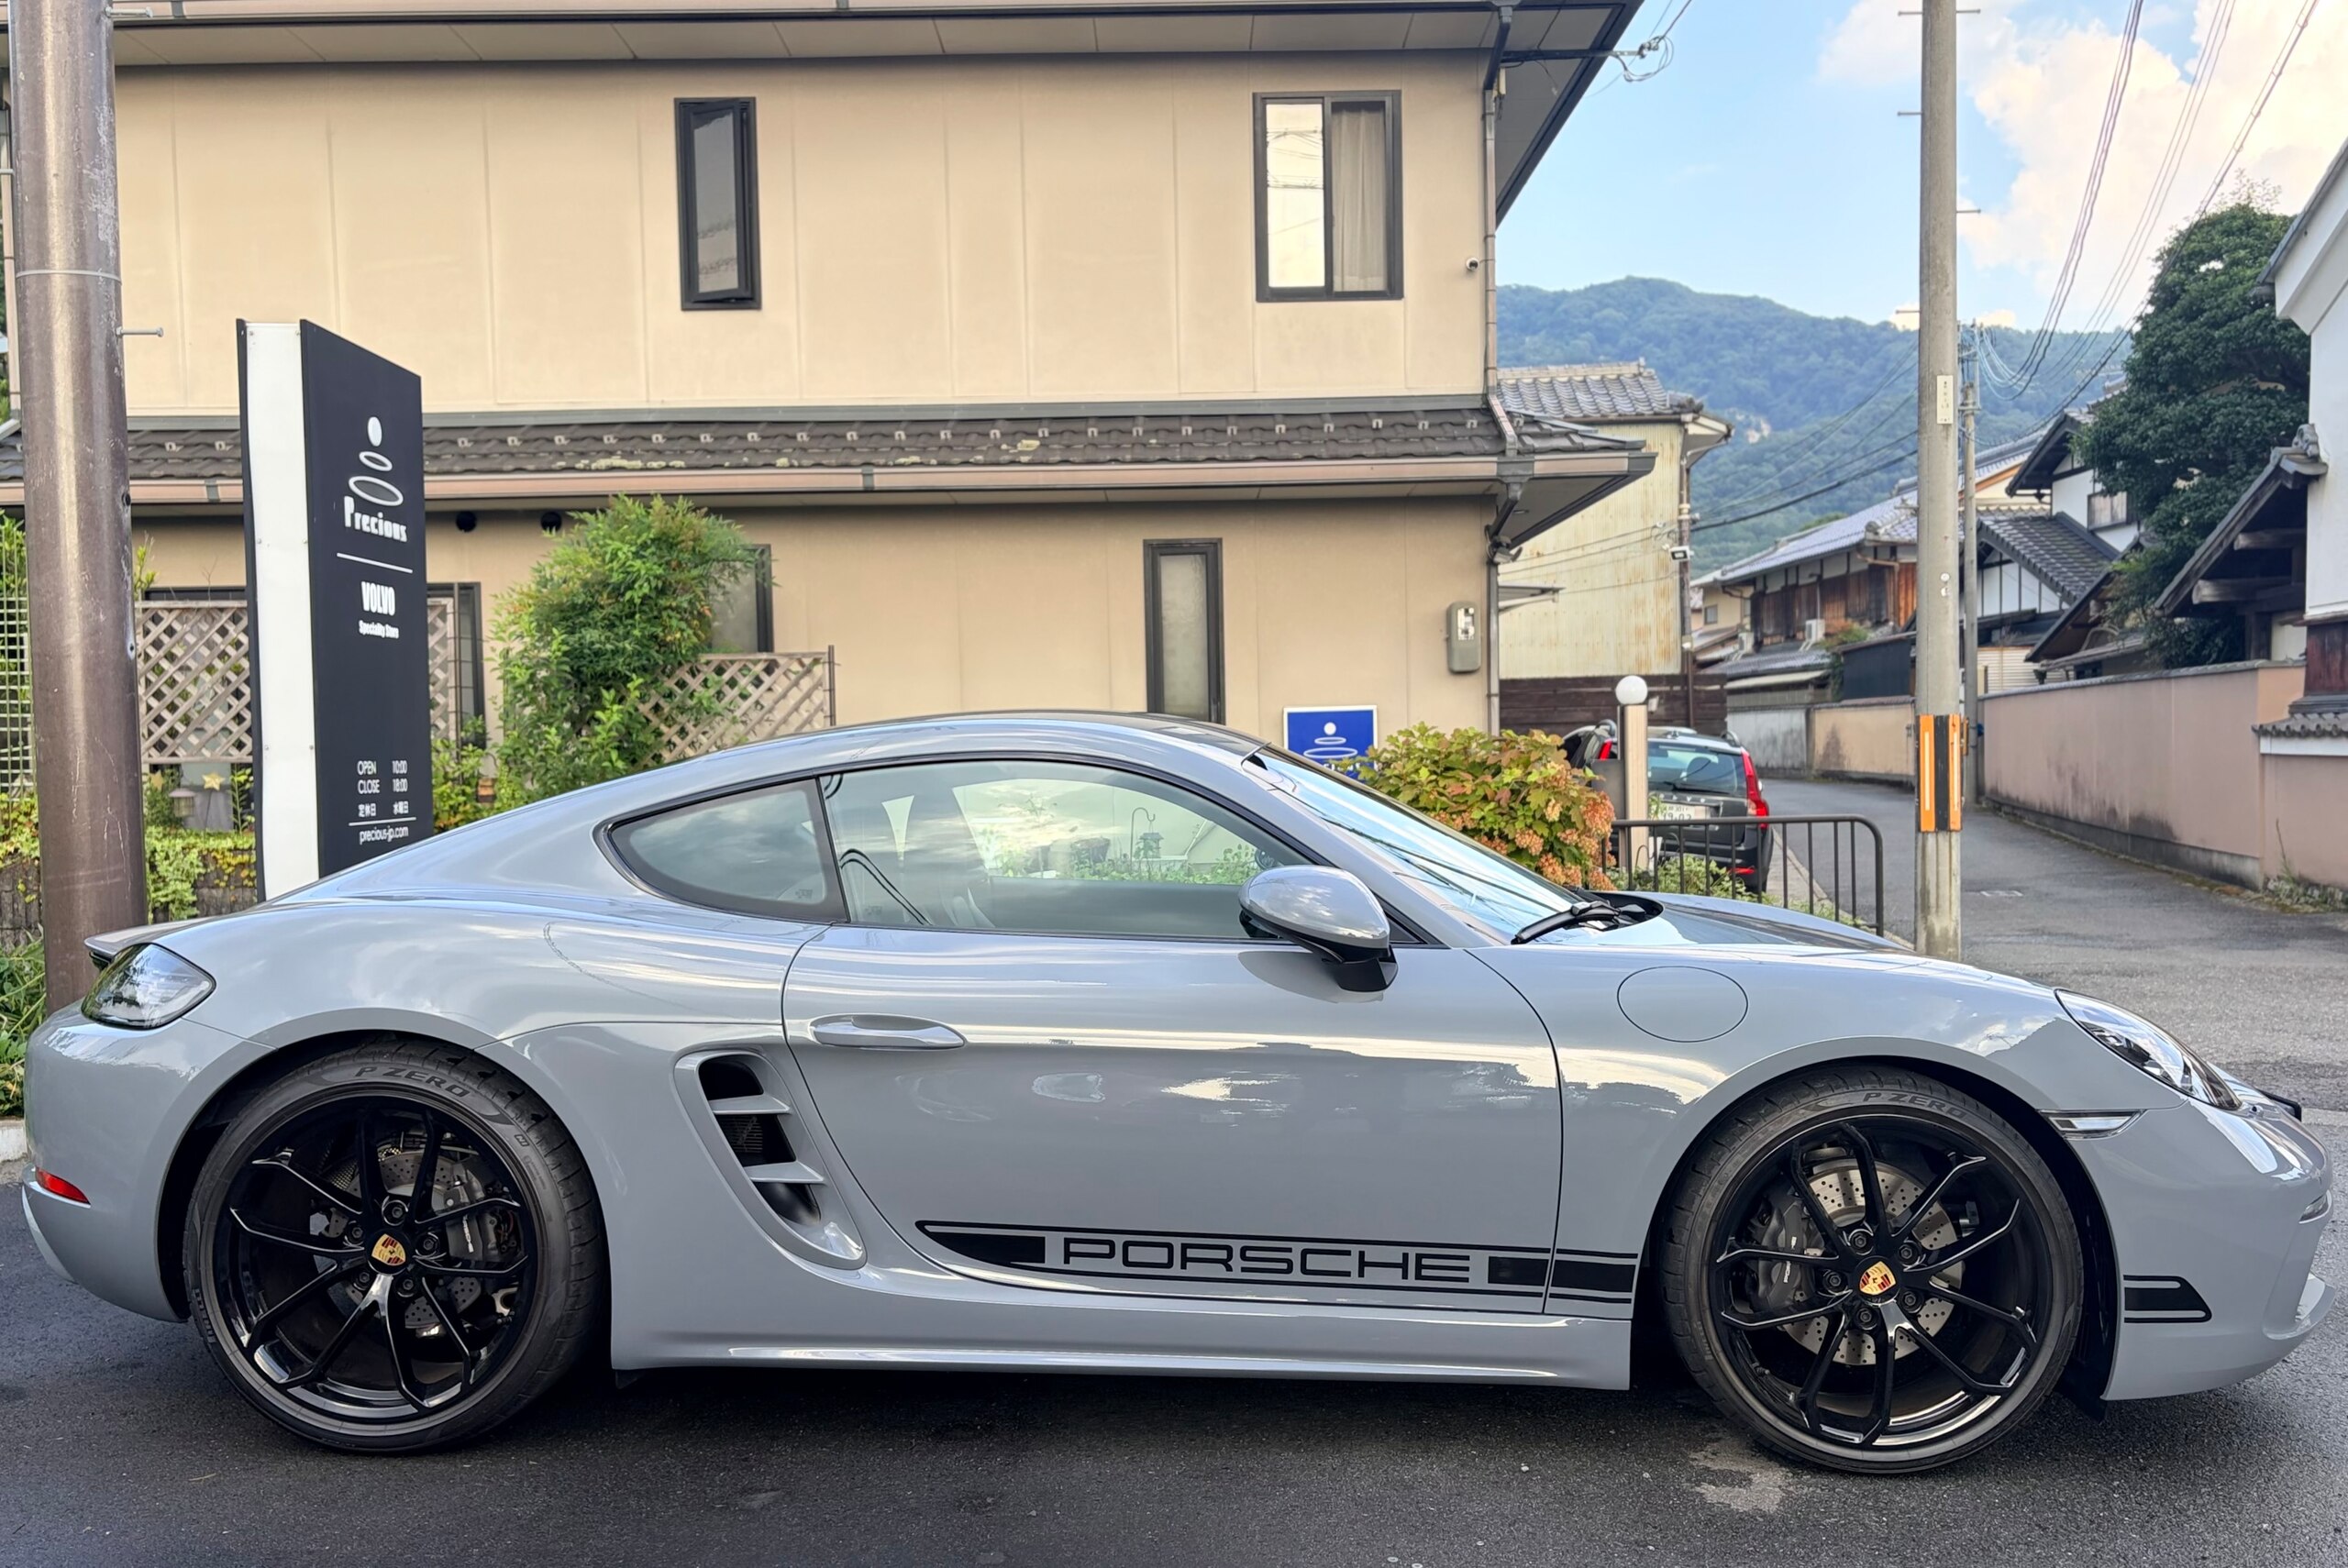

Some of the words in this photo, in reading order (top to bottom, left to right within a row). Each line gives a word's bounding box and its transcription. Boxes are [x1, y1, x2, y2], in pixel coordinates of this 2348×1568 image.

[344, 495, 408, 543] Precious
[360, 580, 396, 616] VOLVO
[358, 761, 376, 775] OPEN
[393, 760, 407, 774] 10:00
[359, 779, 380, 794] CLOSE
[393, 778, 407, 792] 18:00
[359, 803, 376, 817] 定休日
[393, 801, 408, 814] 水曜日
[360, 825, 408, 845] precious-jp.com
[355, 1066, 378, 1077] P
[382, 1066, 471, 1099] ZERO
[1863, 1092, 1882, 1102] P
[1888, 1092, 1968, 1119] ZERO
[1063, 1236, 1471, 1284] PORSCHE
